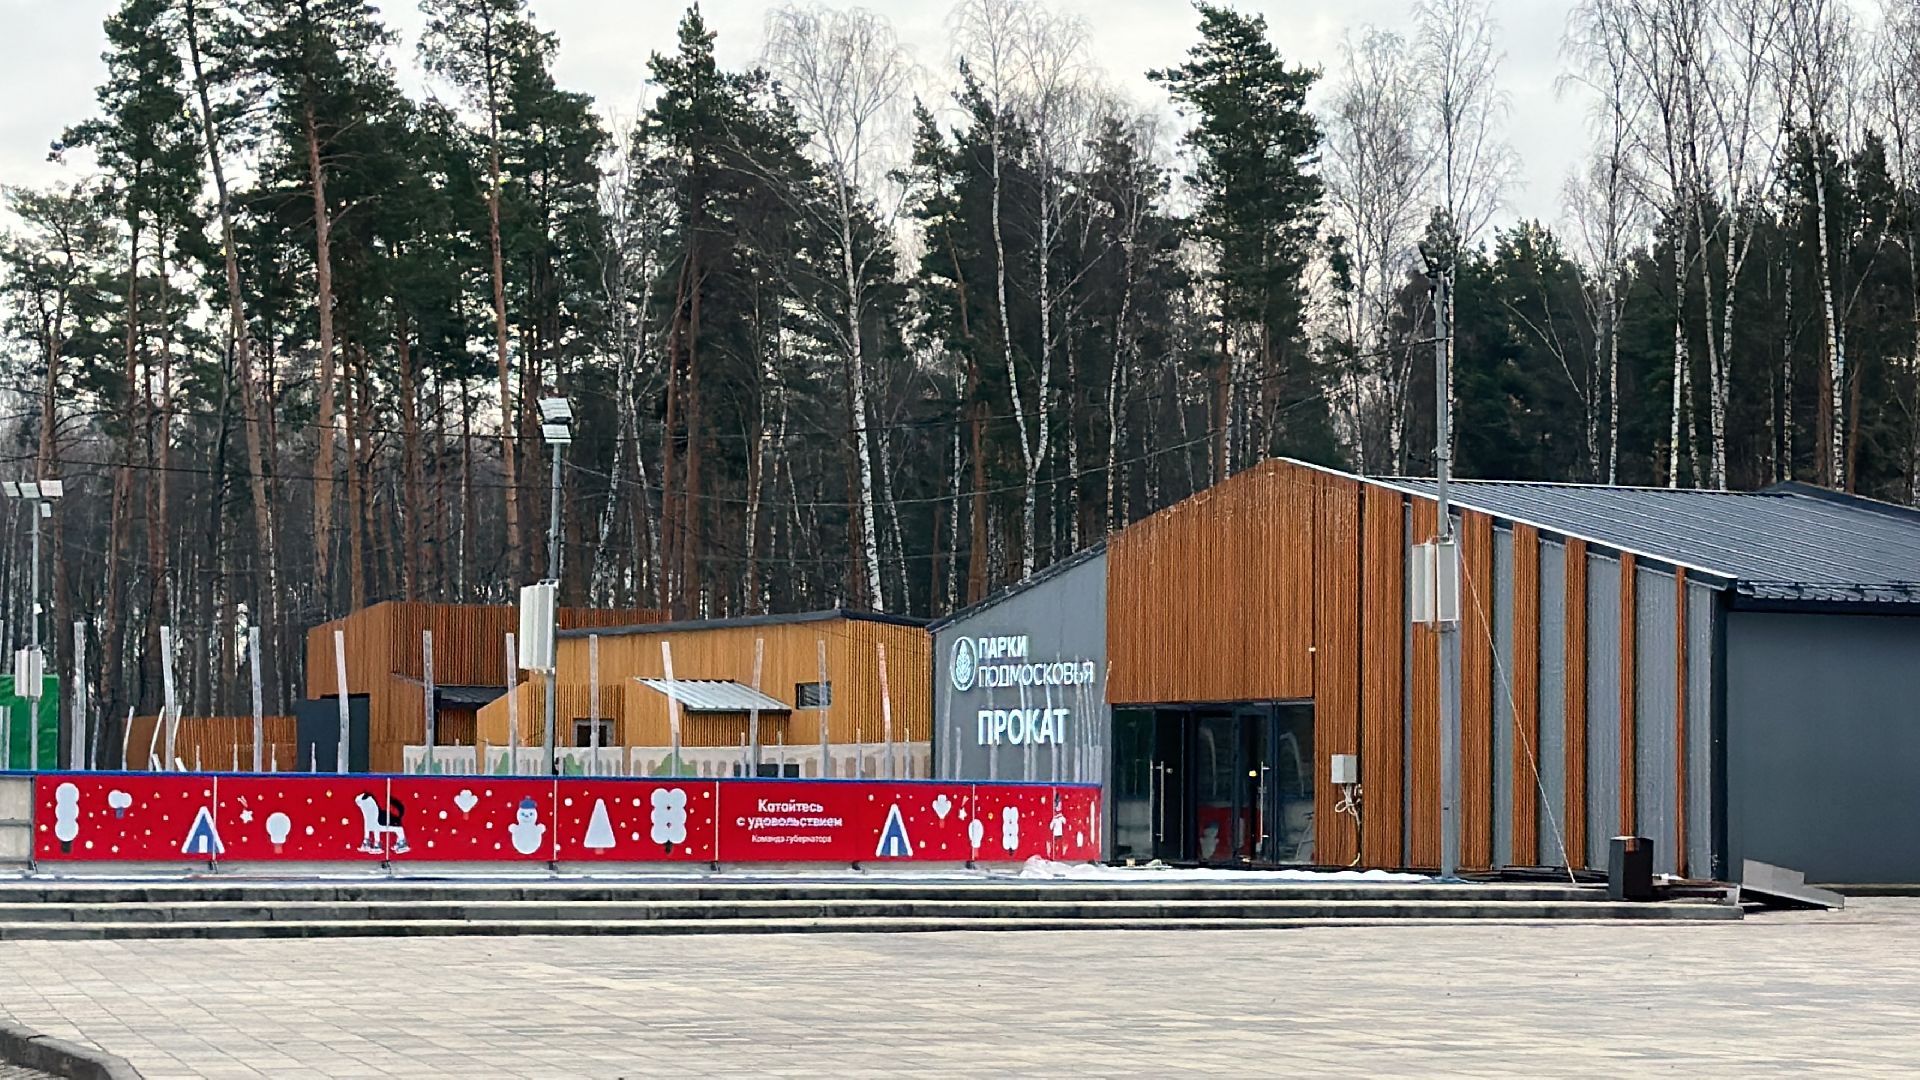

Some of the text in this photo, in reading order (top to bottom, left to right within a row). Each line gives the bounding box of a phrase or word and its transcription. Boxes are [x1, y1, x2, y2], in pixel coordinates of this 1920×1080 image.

[978, 635, 1027, 659] ПАРКИ
[978, 661, 1095, 688] ПОДМОСКОВЬЯ
[978, 708, 1070, 746] ПРОКАТ
[758, 799, 824, 813] Катайтесь
[736, 816, 843, 831] с удовольствием
